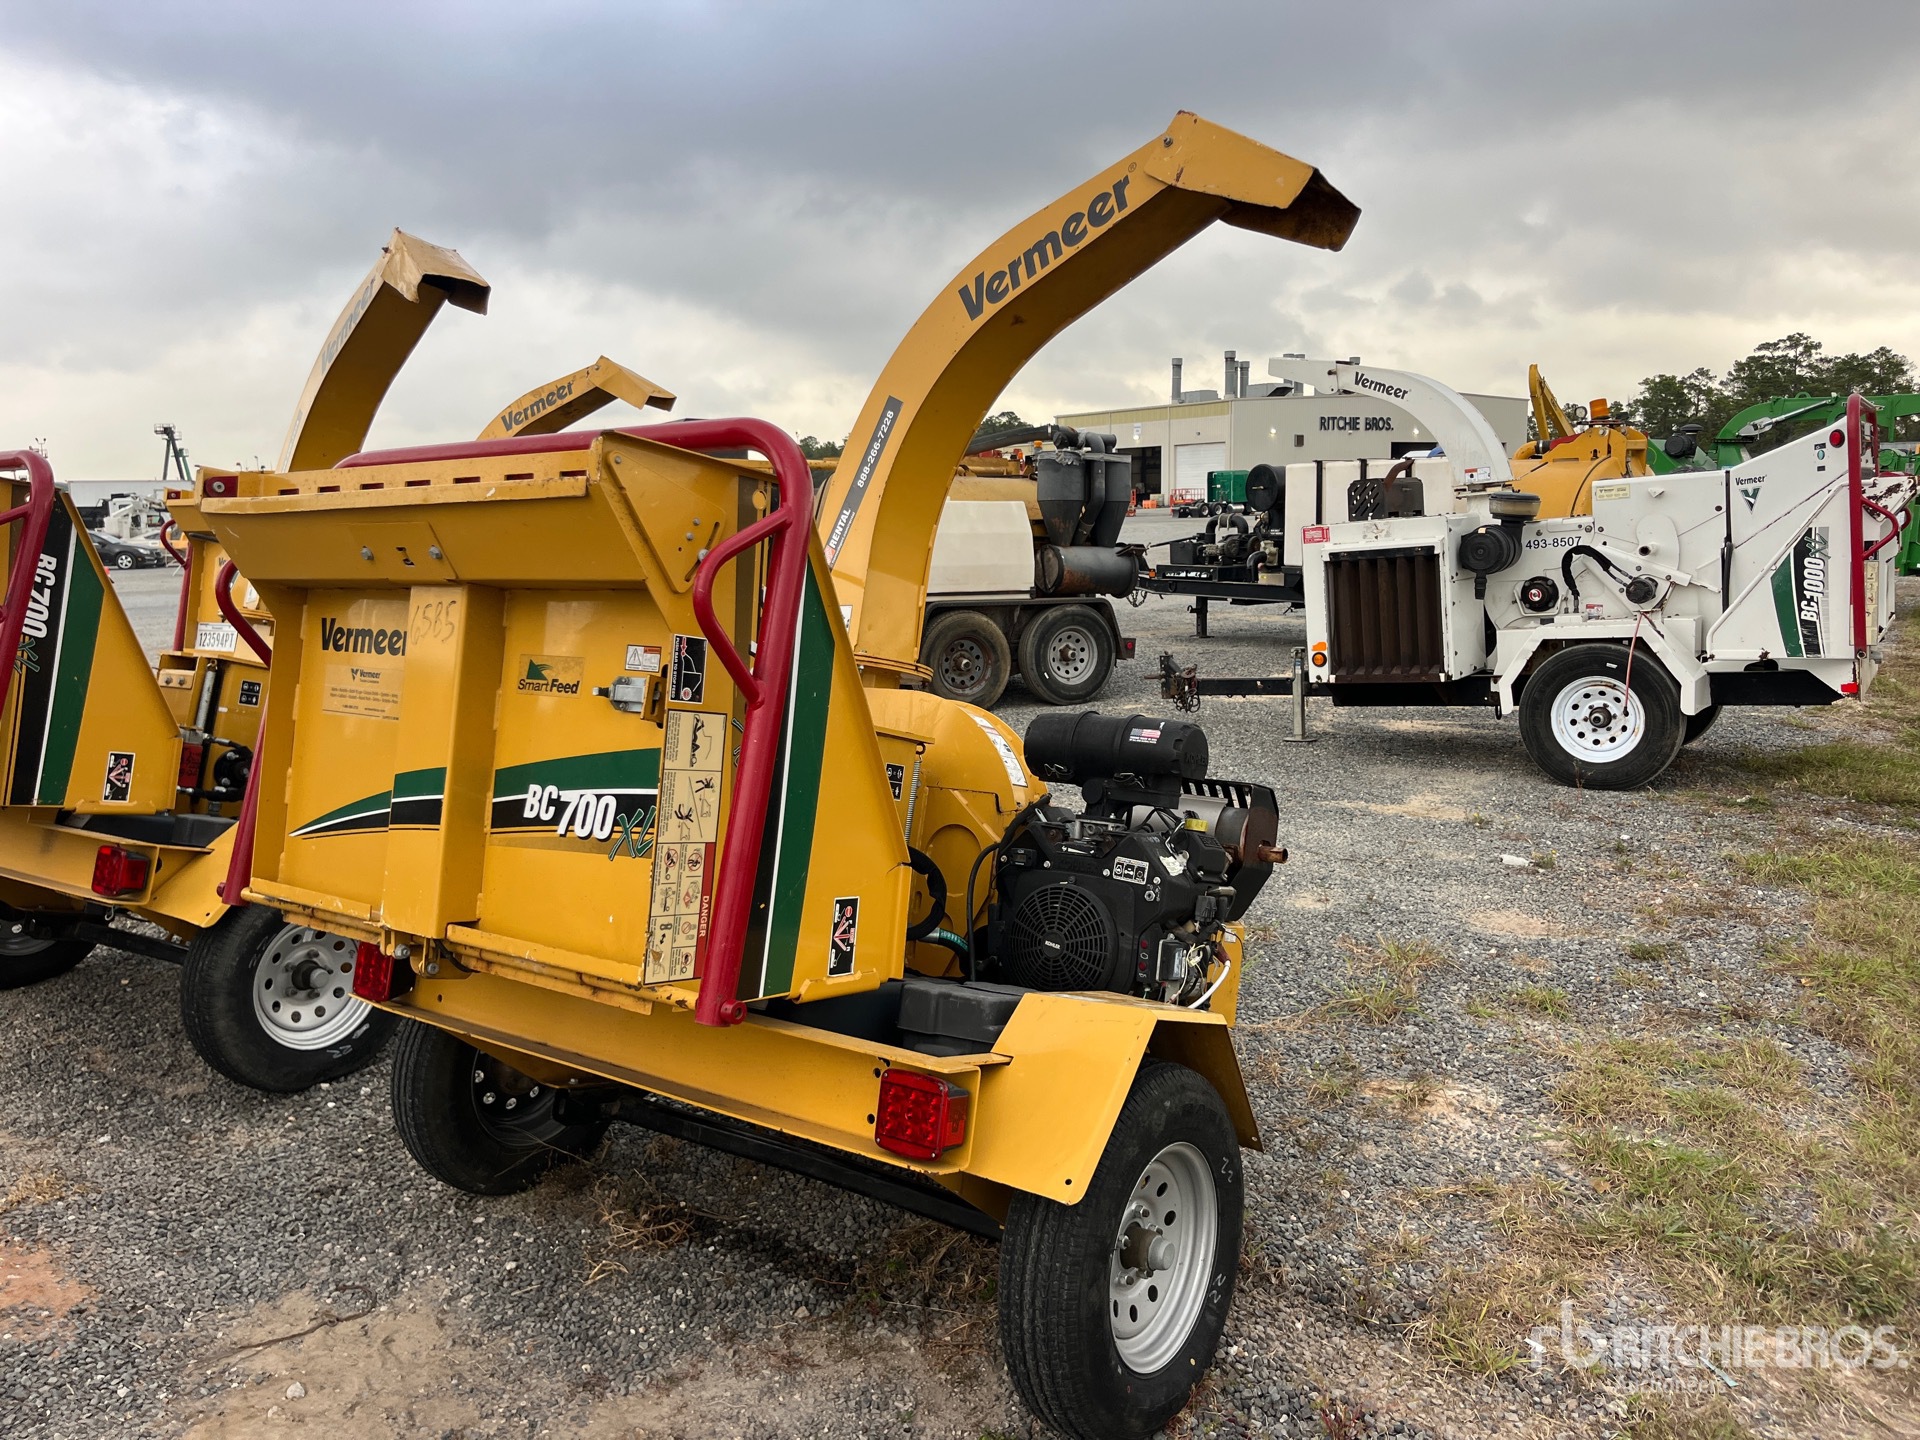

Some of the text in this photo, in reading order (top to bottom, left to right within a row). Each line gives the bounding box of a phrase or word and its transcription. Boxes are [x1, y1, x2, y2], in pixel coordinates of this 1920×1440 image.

[957, 173, 1131, 322] Vermeer
[500, 380, 576, 432] Vermeer
[1354, 371, 1409, 400] Vermeer
[1319, 416, 1394, 431] RITCHIE BROS.
[857, 410, 894, 489] 888-266-7228
[1735, 475, 1767, 486] Vermeer
[829, 507, 851, 549] RENTAL
[1525, 536, 1582, 549] 493-8507
[1800, 557, 1826, 621] BC1000
[199, 632, 235, 649] 123594PT
[523, 784, 617, 841] BC700
[699, 895, 710, 938] DANGER
[1045, 940, 1061, 950] KOHLER
